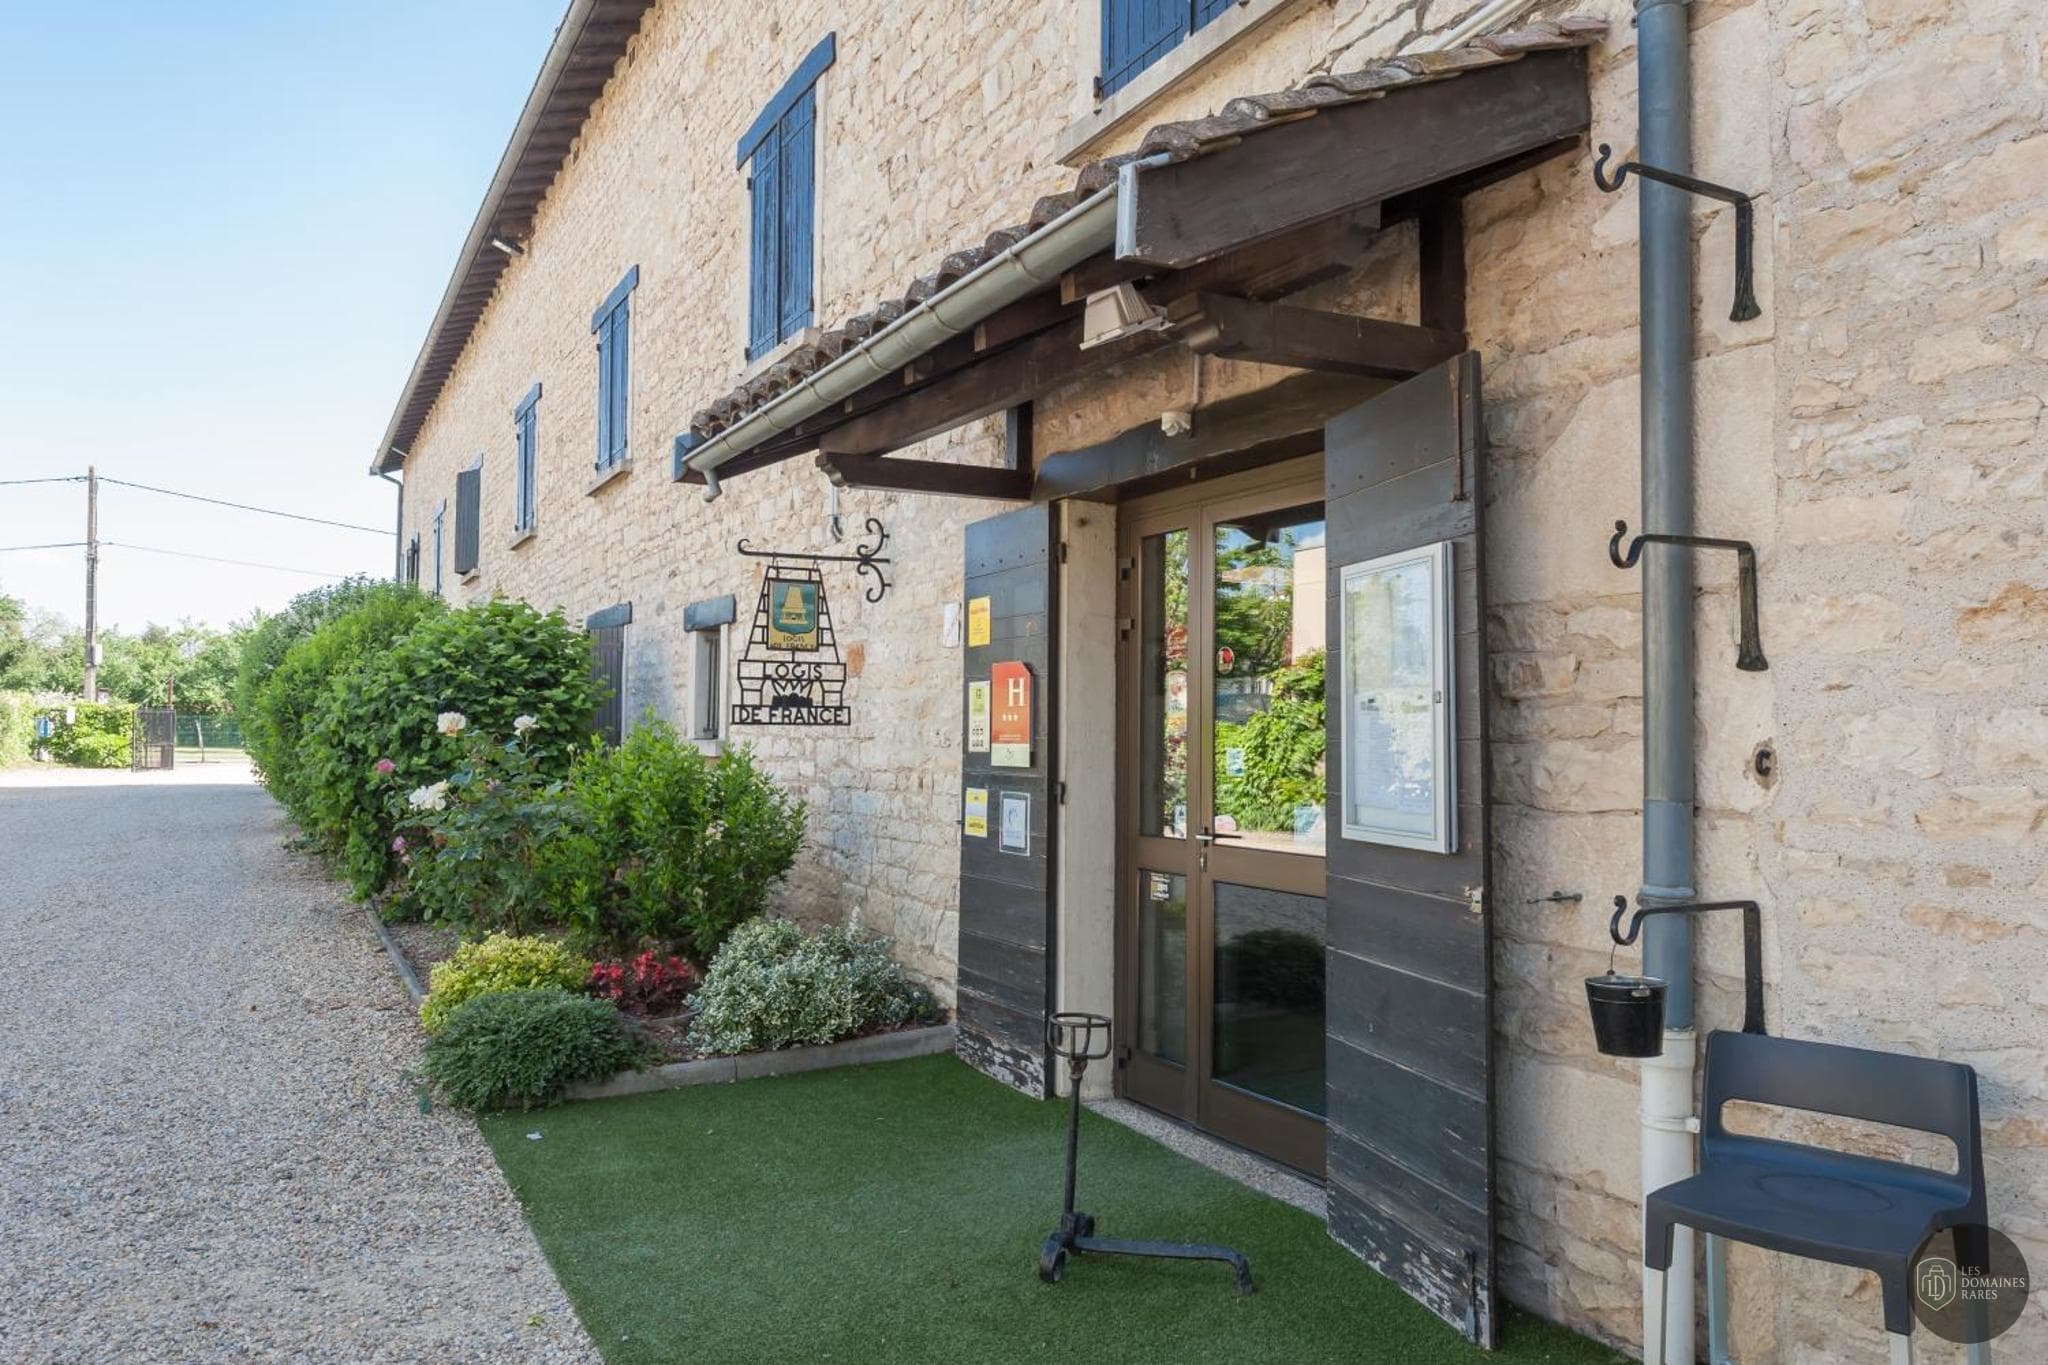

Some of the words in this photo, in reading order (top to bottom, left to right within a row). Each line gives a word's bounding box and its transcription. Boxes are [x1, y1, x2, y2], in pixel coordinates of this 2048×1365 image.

[763, 662, 823, 681] LOGIS
[1007, 677, 1025, 707] H
[740, 707, 762, 723] DE
[769, 707, 843, 724] FRANCE
